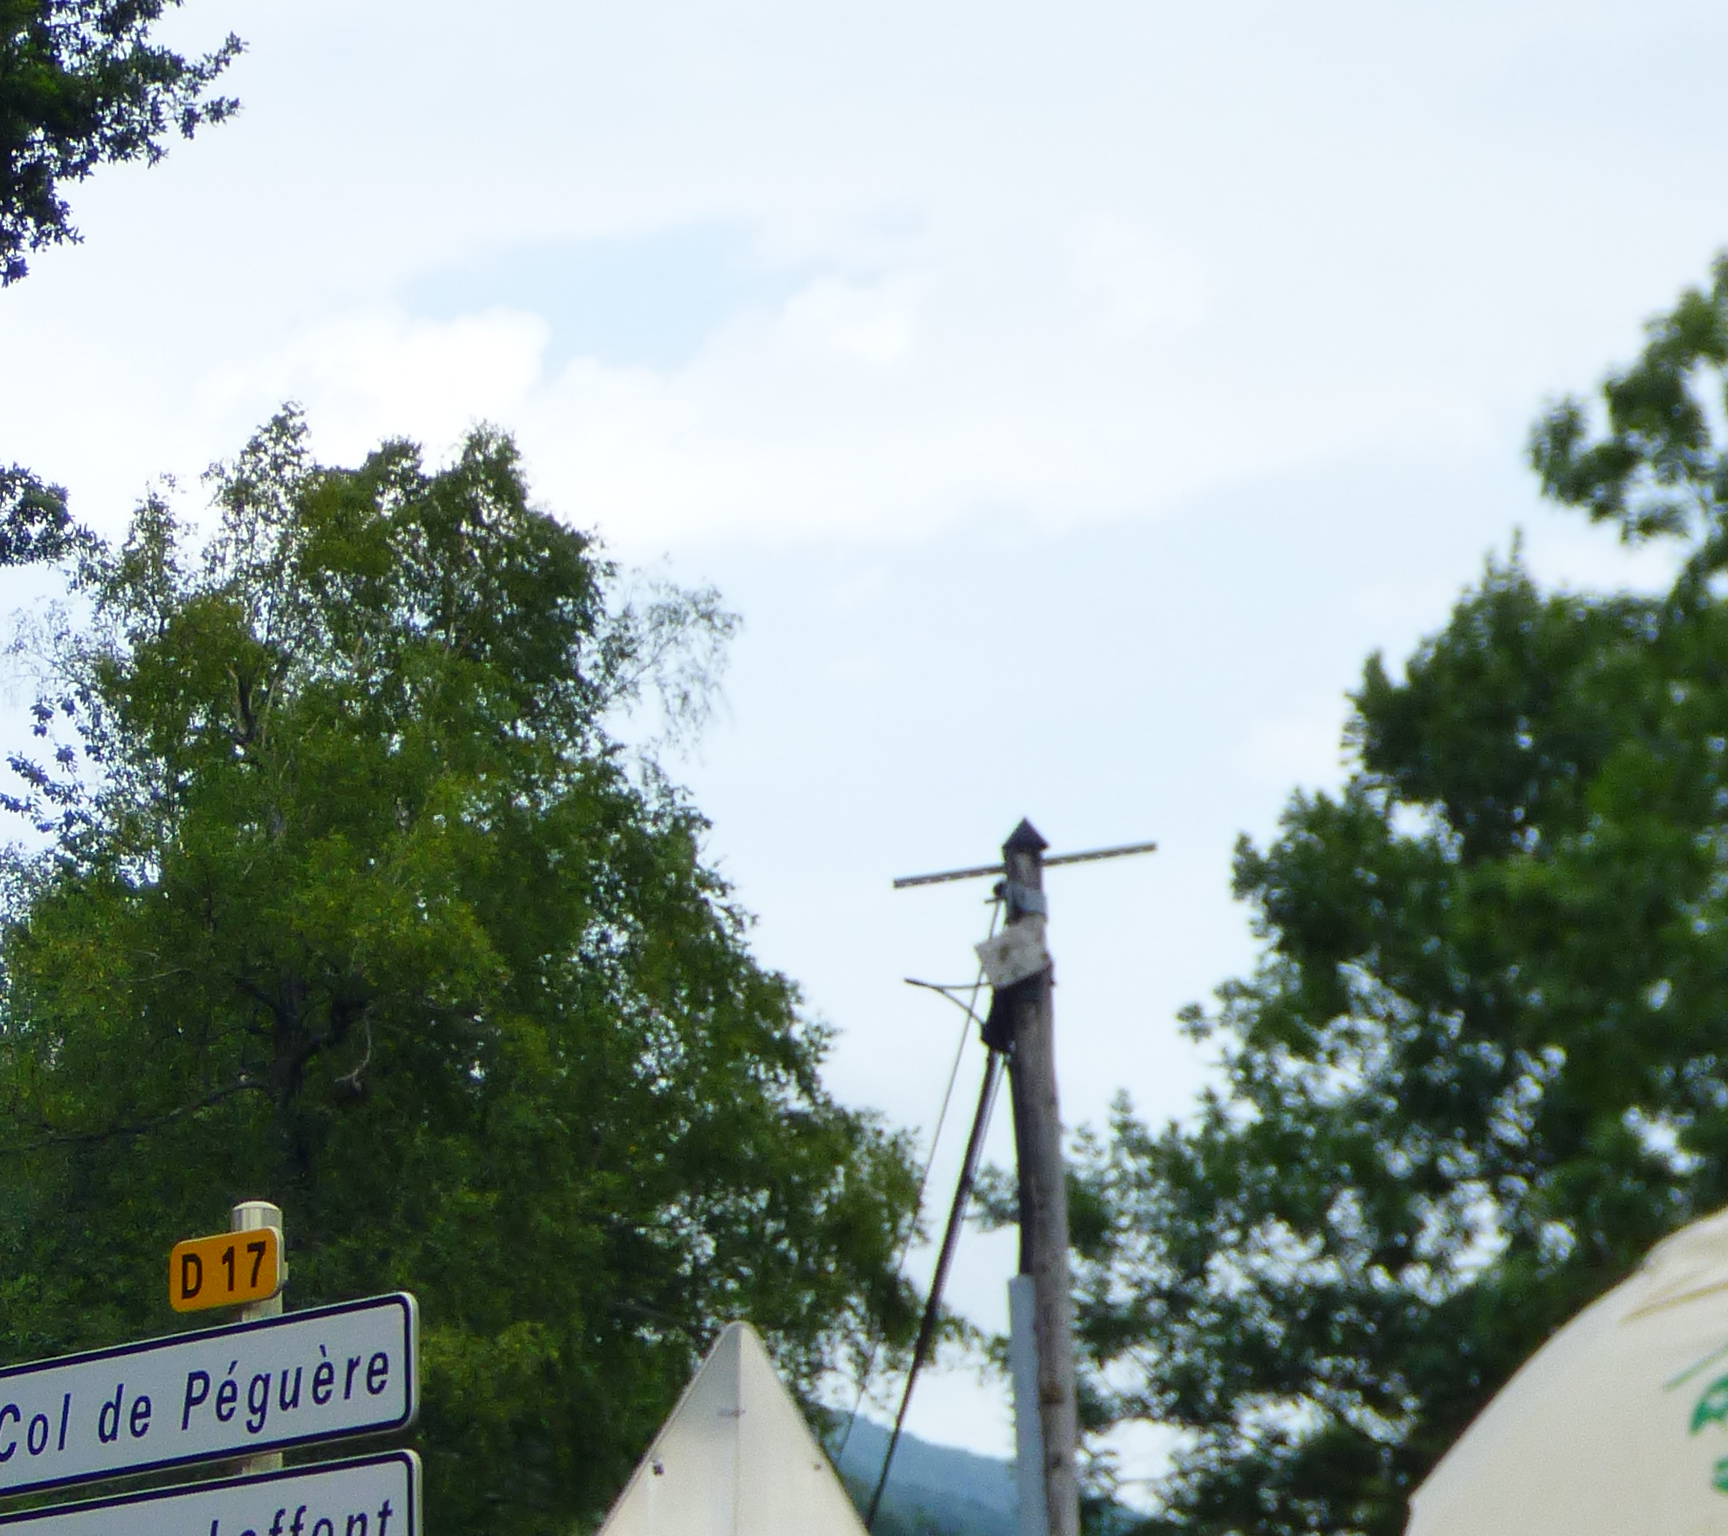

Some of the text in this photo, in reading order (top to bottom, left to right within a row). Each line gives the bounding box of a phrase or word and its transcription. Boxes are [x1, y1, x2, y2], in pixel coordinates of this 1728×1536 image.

[181, 1241, 267, 1299] D 17
[98, 1383, 152, 1444] de
[181, 1345, 389, 1434] Péguère
